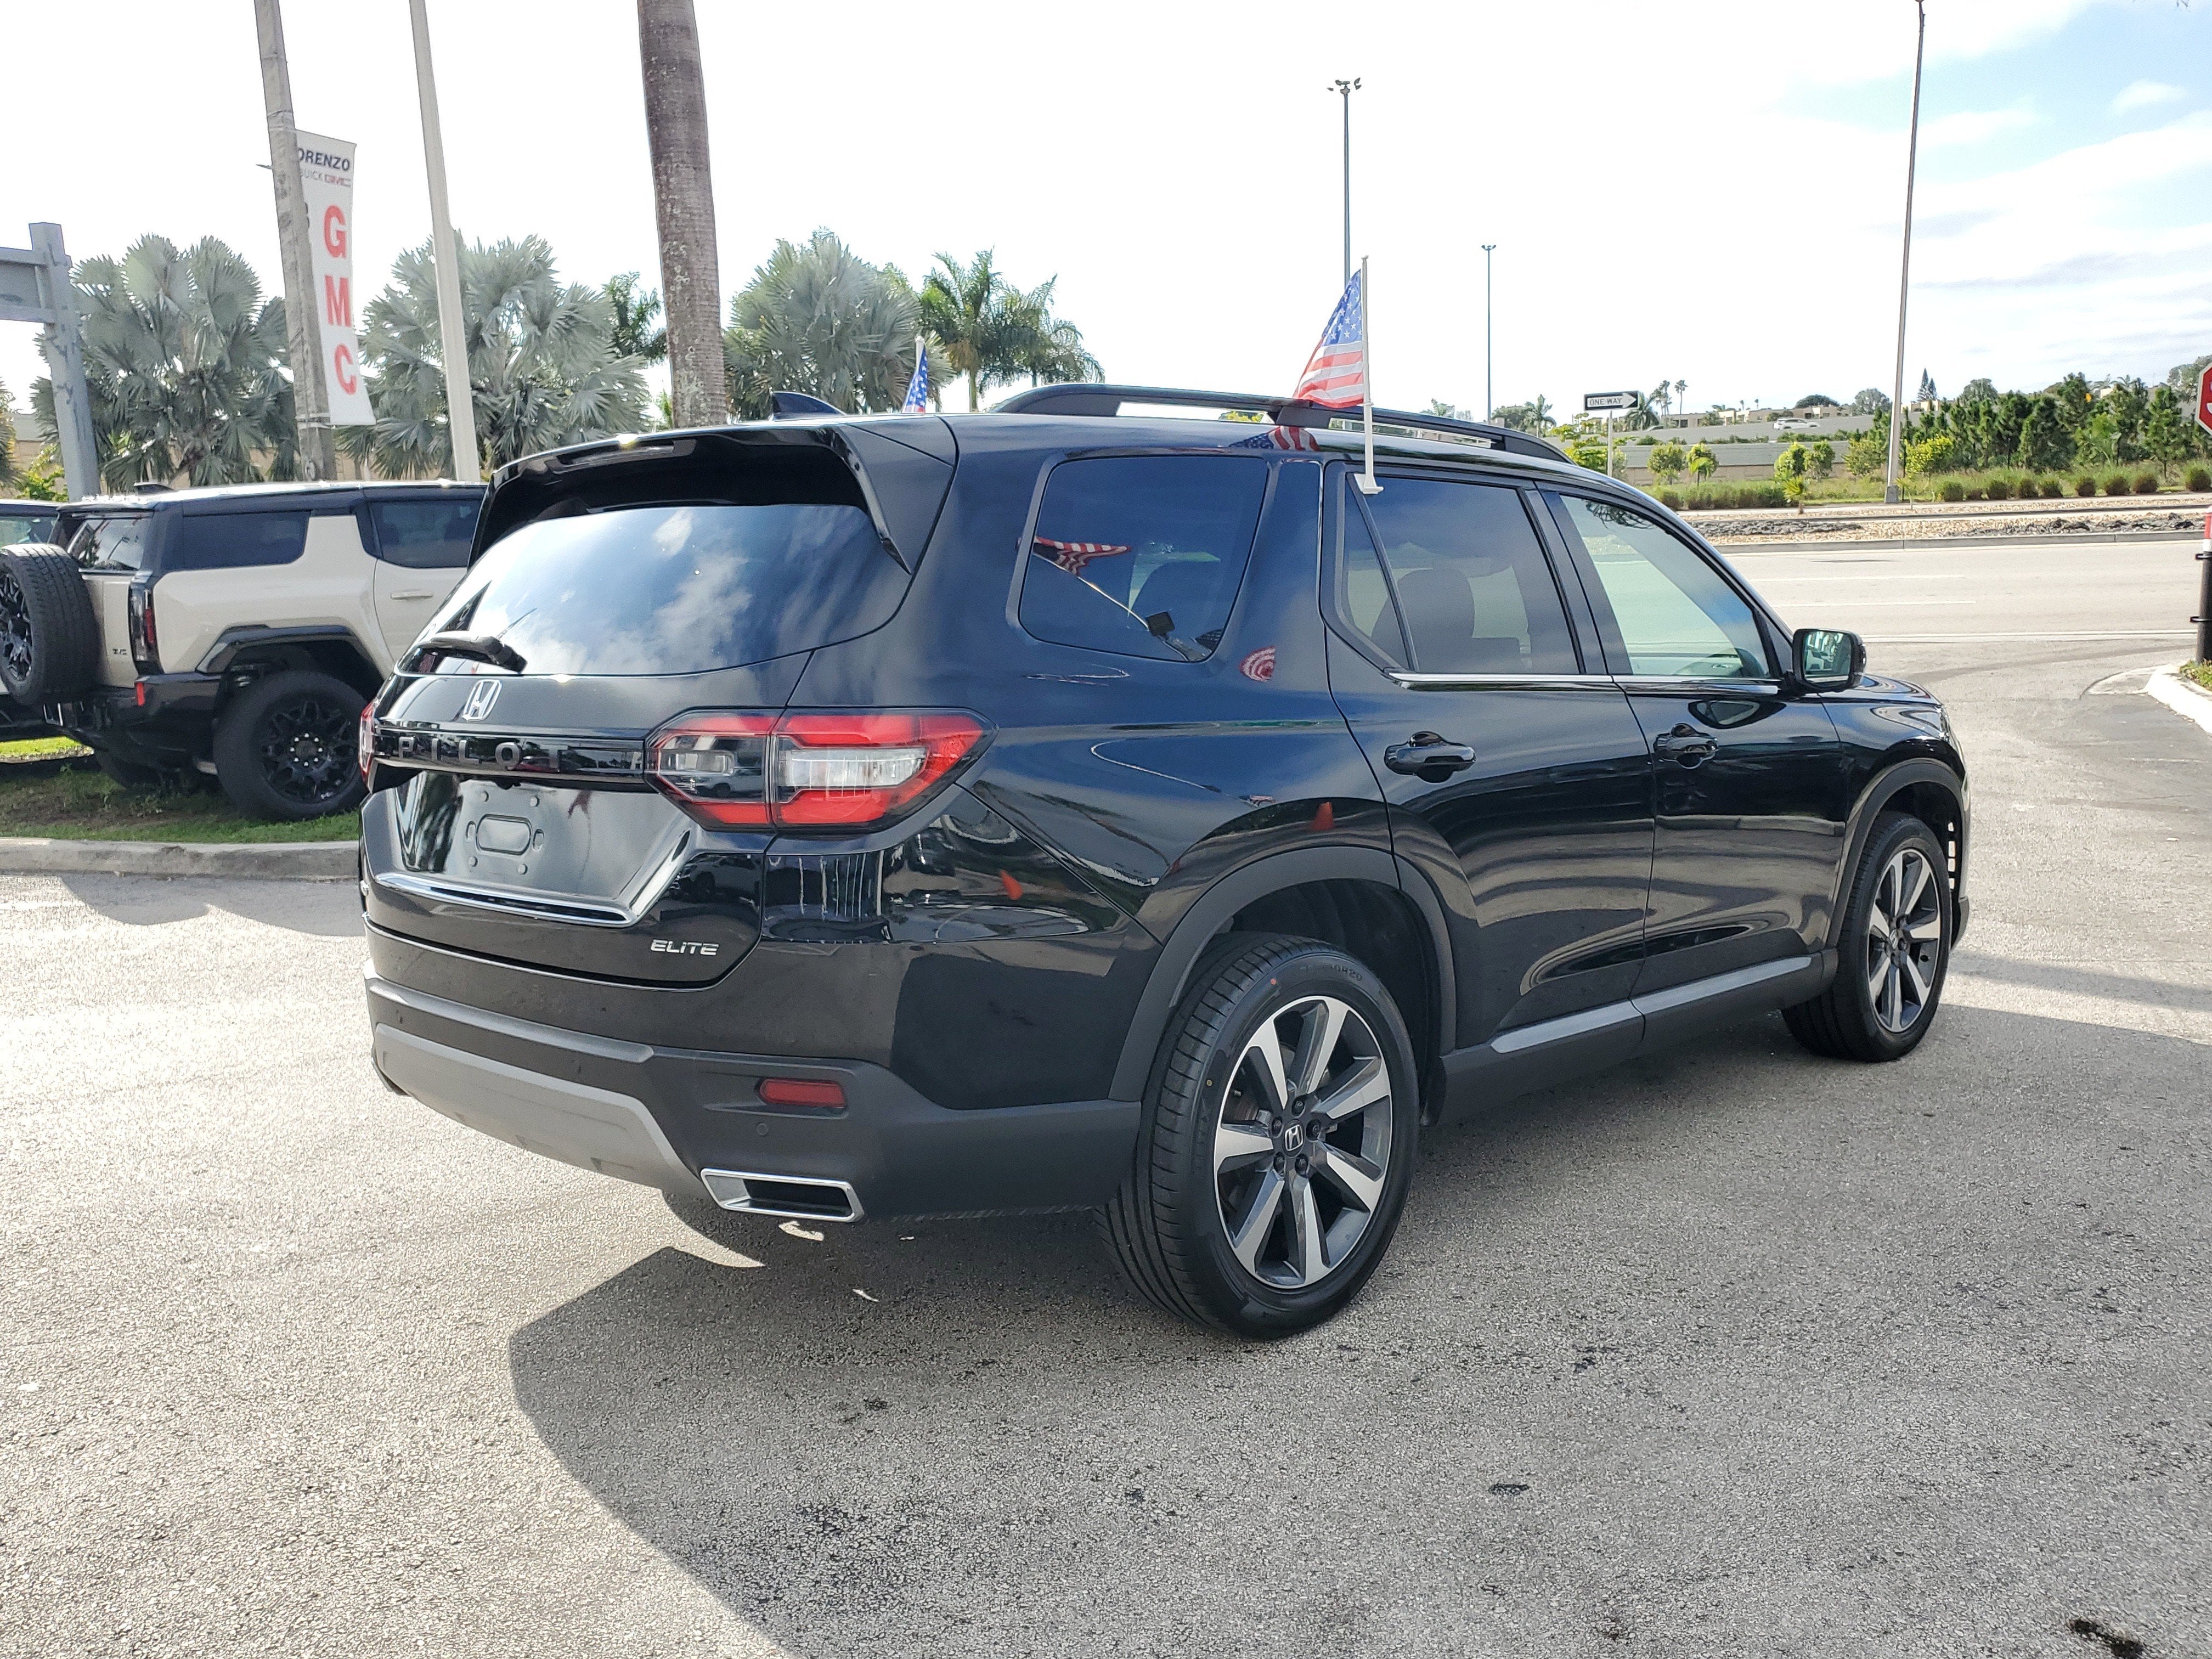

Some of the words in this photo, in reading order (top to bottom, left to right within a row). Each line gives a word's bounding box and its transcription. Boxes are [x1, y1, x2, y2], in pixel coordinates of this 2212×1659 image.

[298, 148, 350, 171] ORENZO
[324, 204, 357, 395] GMC
[398, 736, 568, 770] PILOT
[651, 939, 719, 956] ELITE
